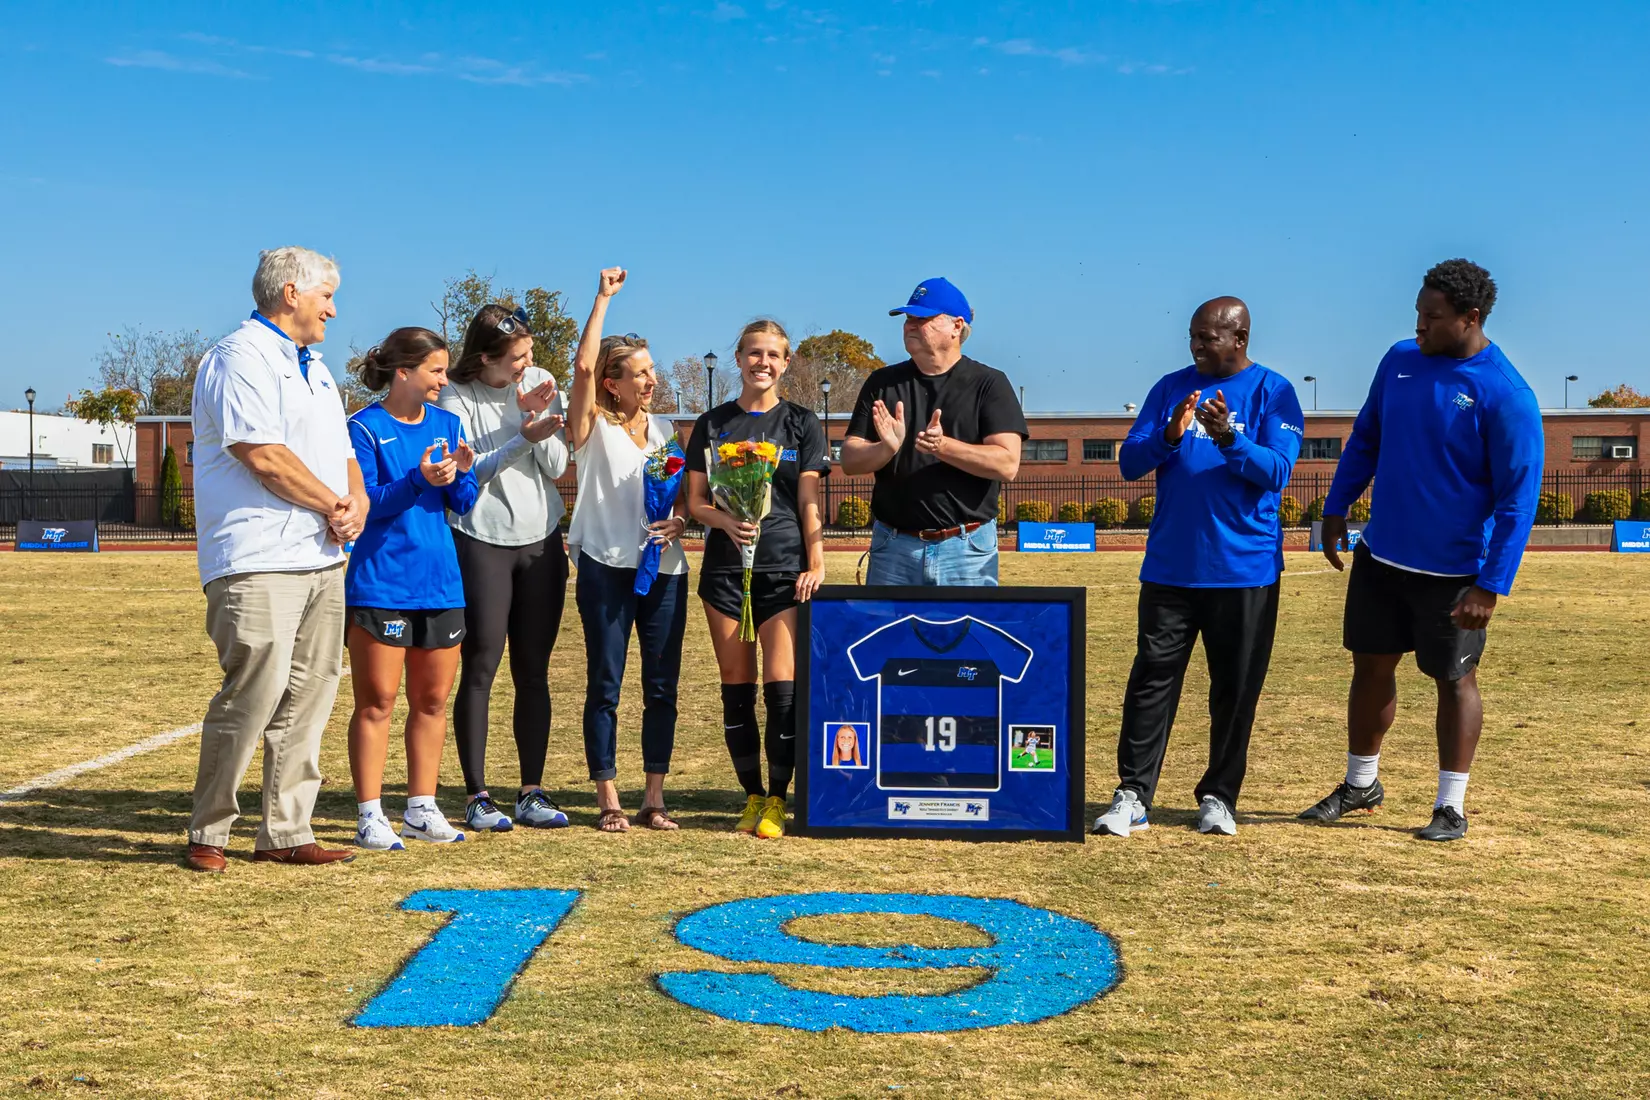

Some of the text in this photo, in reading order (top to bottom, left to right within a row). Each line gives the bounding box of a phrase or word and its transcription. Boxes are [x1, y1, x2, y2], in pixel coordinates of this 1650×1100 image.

[42, 528, 66, 542] MT
[1044, 529, 1067, 544] MT
[384, 622, 405, 638] MT
[957, 666, 978, 681] MT
[924, 716, 957, 752] 19
